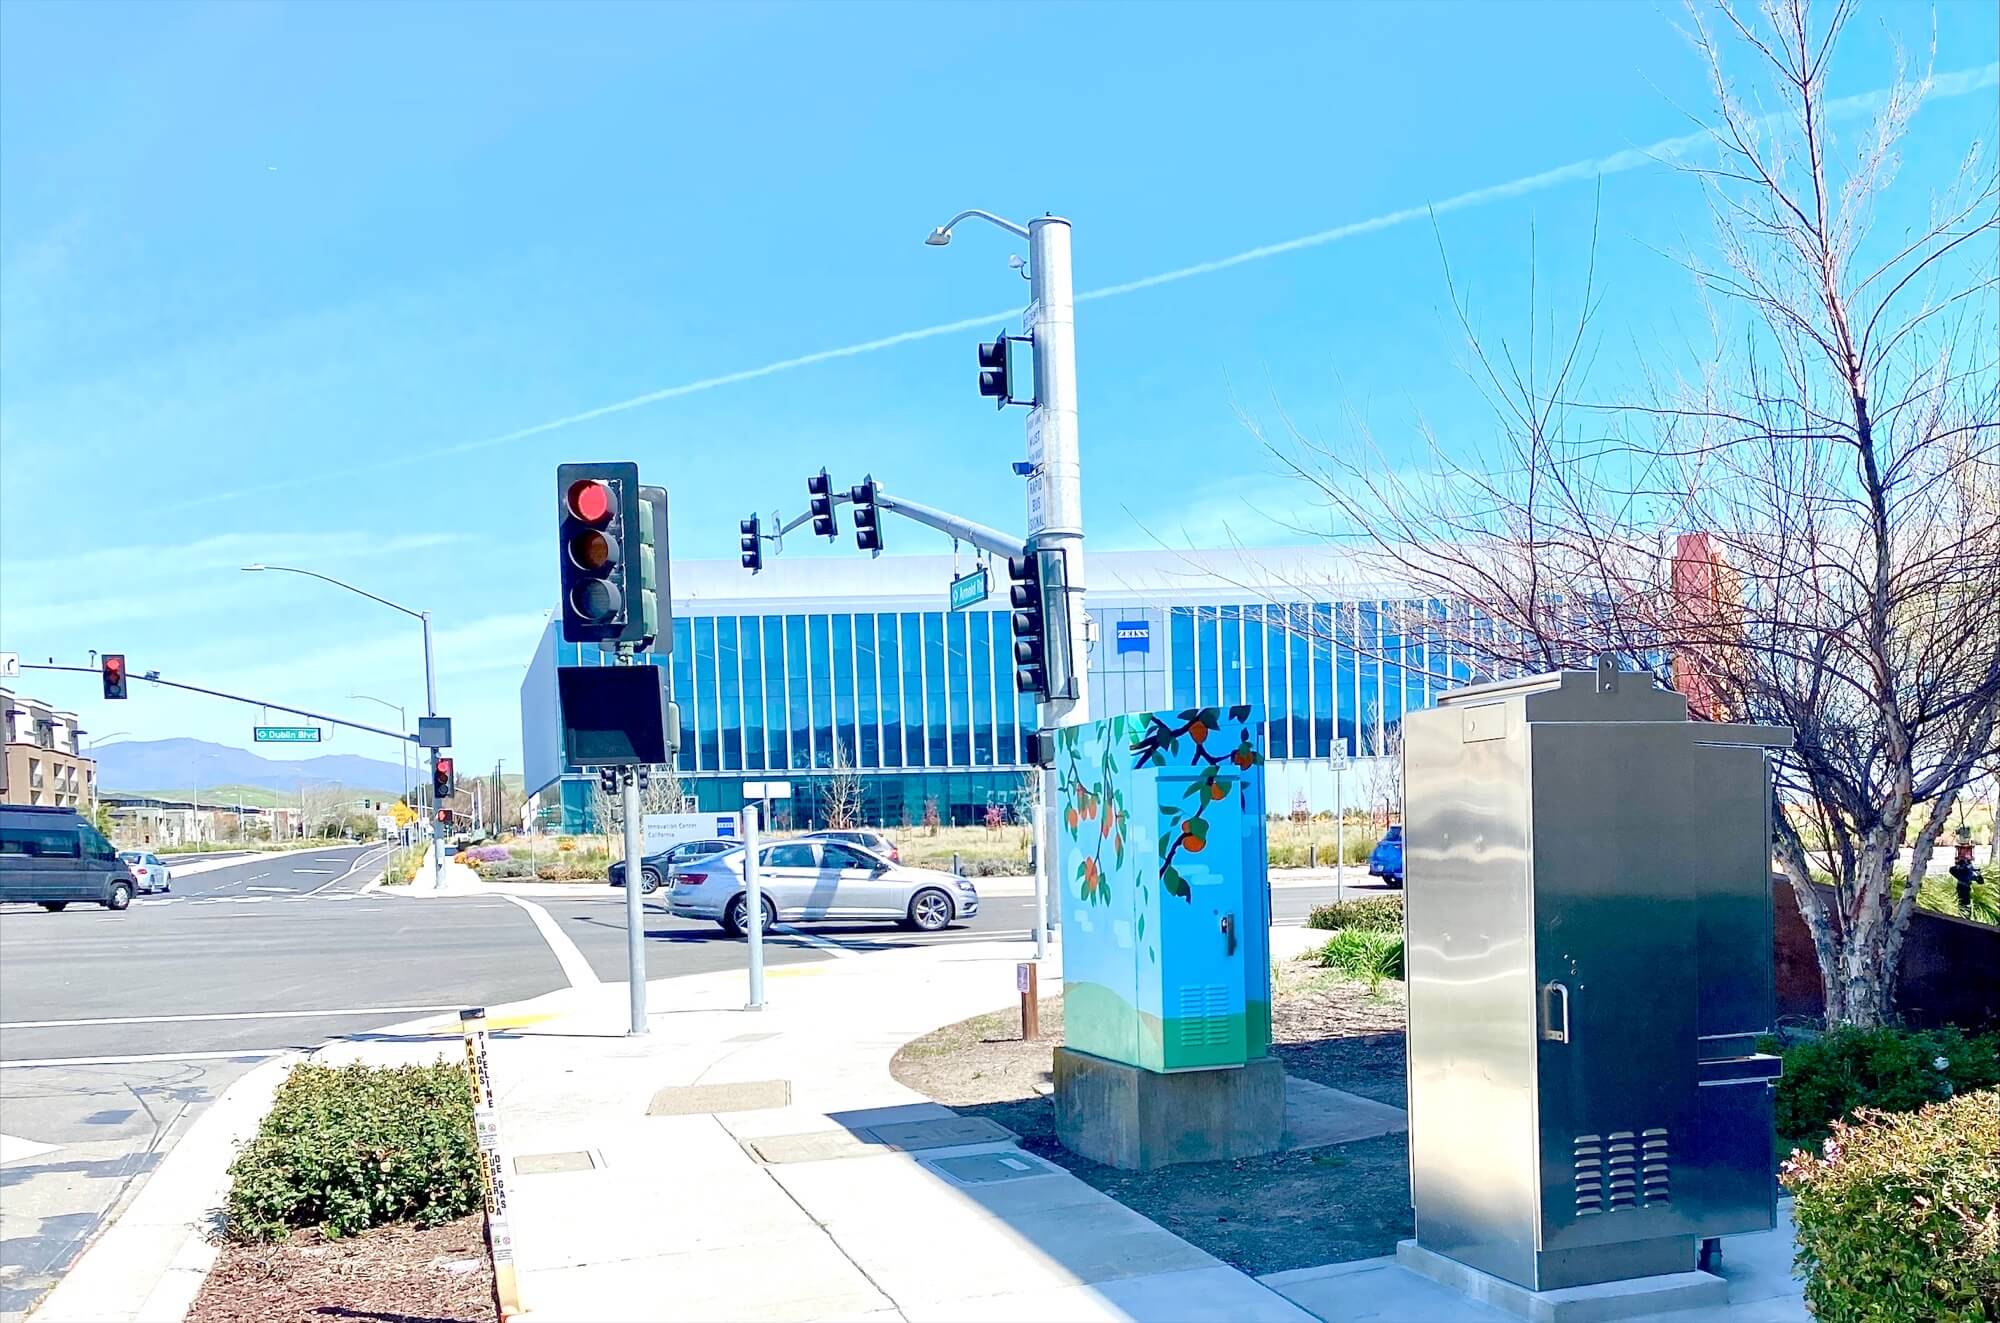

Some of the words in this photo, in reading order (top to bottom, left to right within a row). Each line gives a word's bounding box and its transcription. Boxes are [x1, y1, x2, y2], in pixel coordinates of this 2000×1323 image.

[1032, 496, 1041, 512] BUS
[1117, 629, 1149, 639] ZEISS
[269, 730, 296, 739] Dublin
[298, 730, 317, 739] Blvd
[679, 822, 697, 830] Center
[465, 1038, 480, 1104] WARNING
[476, 1056, 485, 1085] GAS
[478, 1031, 494, 1108] PIPELINE
[495, 1154, 502, 1173] DE
[481, 1152, 495, 1213] PELIGRO
[498, 1180, 506, 1208] GAS
